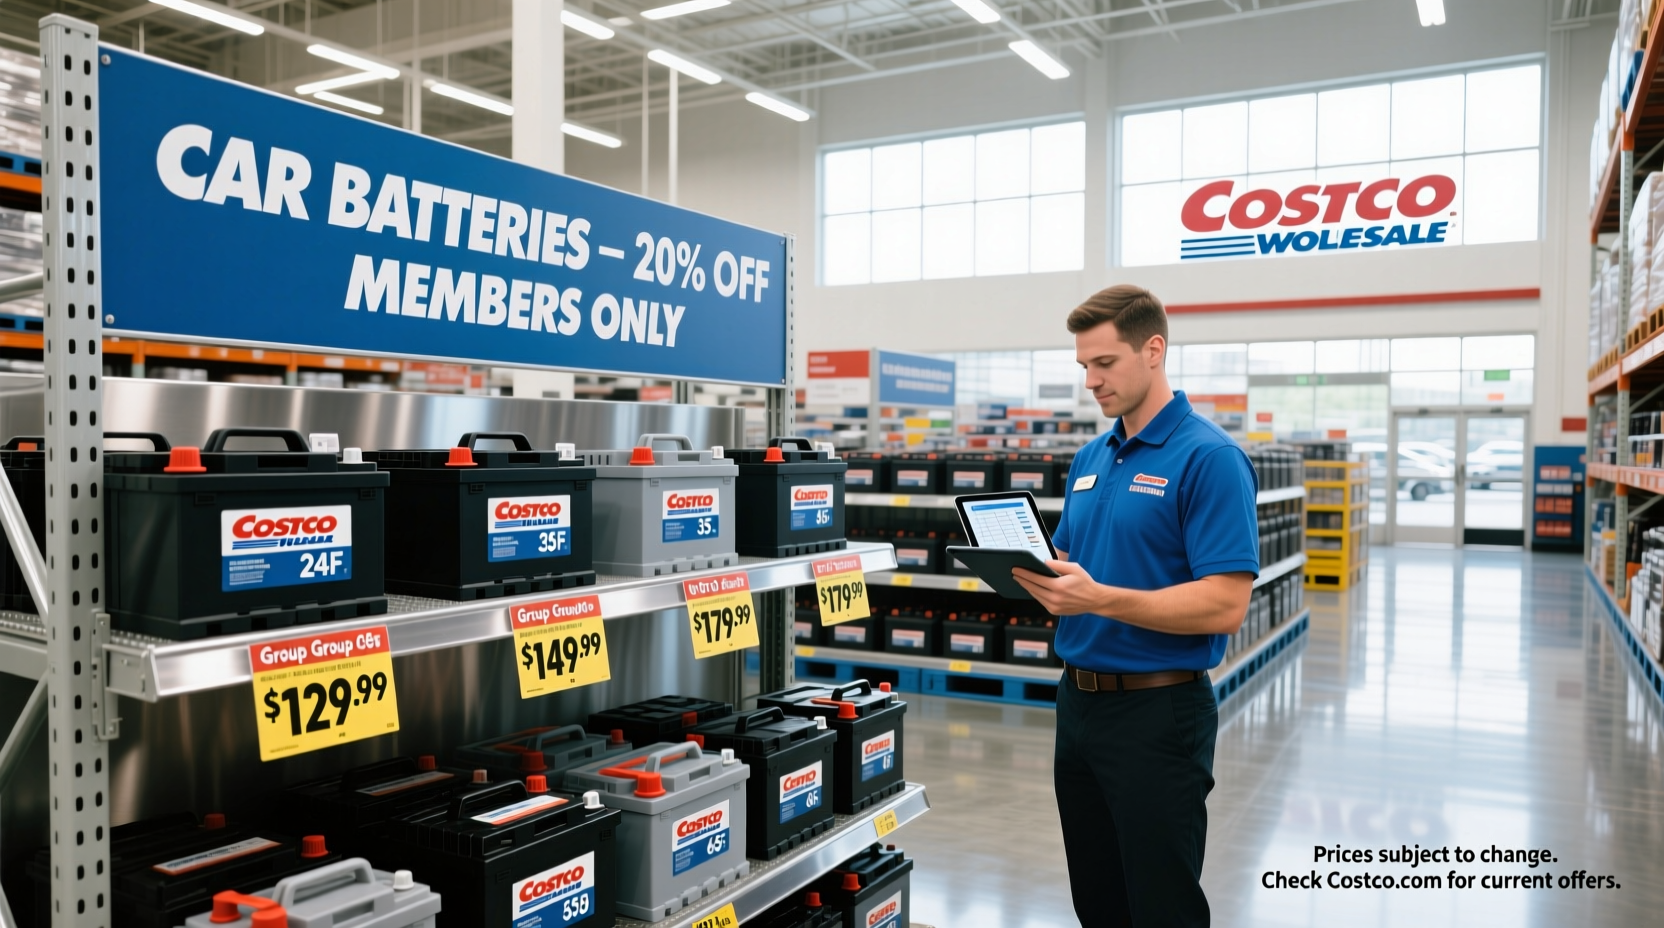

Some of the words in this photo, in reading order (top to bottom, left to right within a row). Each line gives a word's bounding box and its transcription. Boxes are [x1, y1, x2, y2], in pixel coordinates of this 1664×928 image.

[156, 124, 310, 221] CAR
[328, 162, 591, 270] BATTERIES
[633, 231, 706, 292] 20%
[713, 250, 770, 303] OFF
[1181, 174, 1457, 232] COSTCO
[1257, 221, 1449, 254] WOLESALE
[344, 254, 582, 336] MEMBERS
[591, 293, 686, 348] ONLY
[232, 515, 337, 539] COSTCO
[495, 501, 561, 520] COSTCO
[300, 551, 343, 578] 24F
[693, 604, 751, 643] $179.99
[260, 646, 307, 664] Group
[311, 639, 353, 658] Group
[521, 632, 601, 680] $149.99
[264, 671, 387, 737] $129.99
[519, 866, 584, 902] COSTCO
